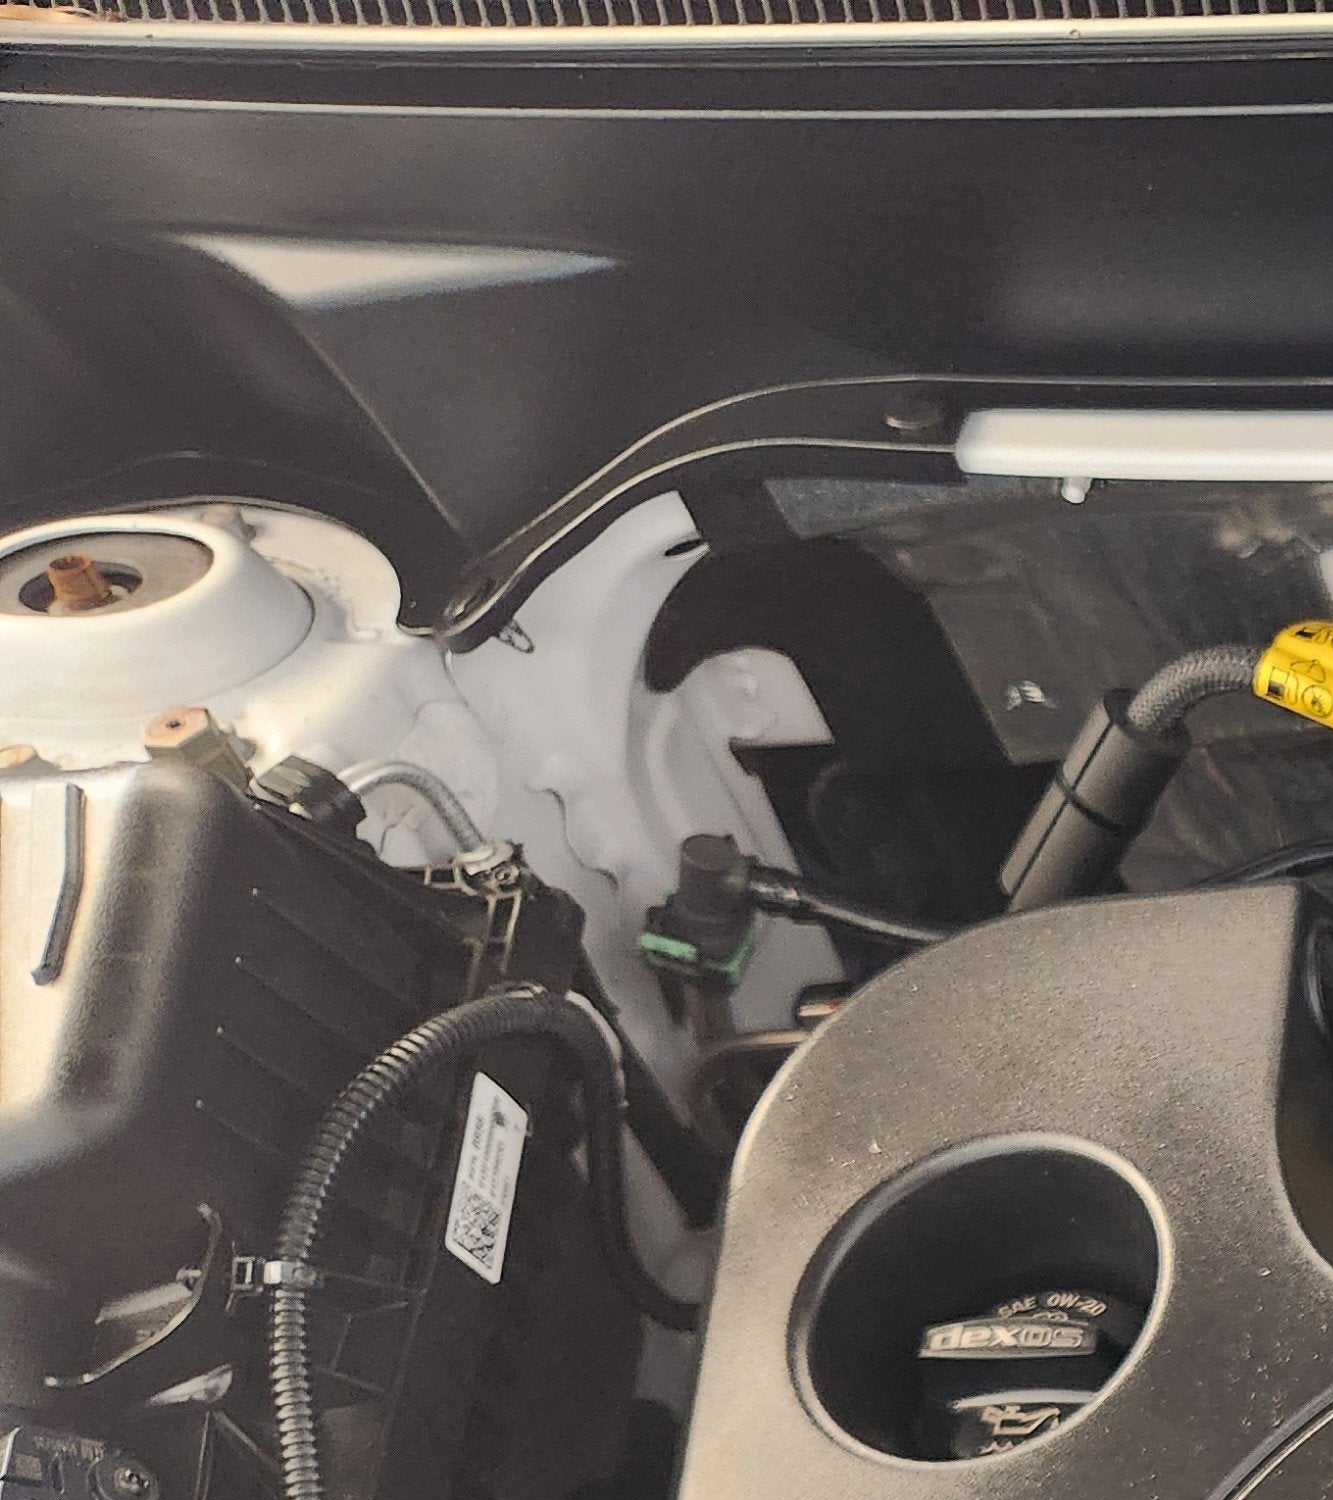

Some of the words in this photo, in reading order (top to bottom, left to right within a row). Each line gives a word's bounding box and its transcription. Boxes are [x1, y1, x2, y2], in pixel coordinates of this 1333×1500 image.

[998, 1296, 1037, 1319] SAE
[1047, 1293, 1107, 1317] 0W-20
[929, 1324, 1085, 1350] dexos
